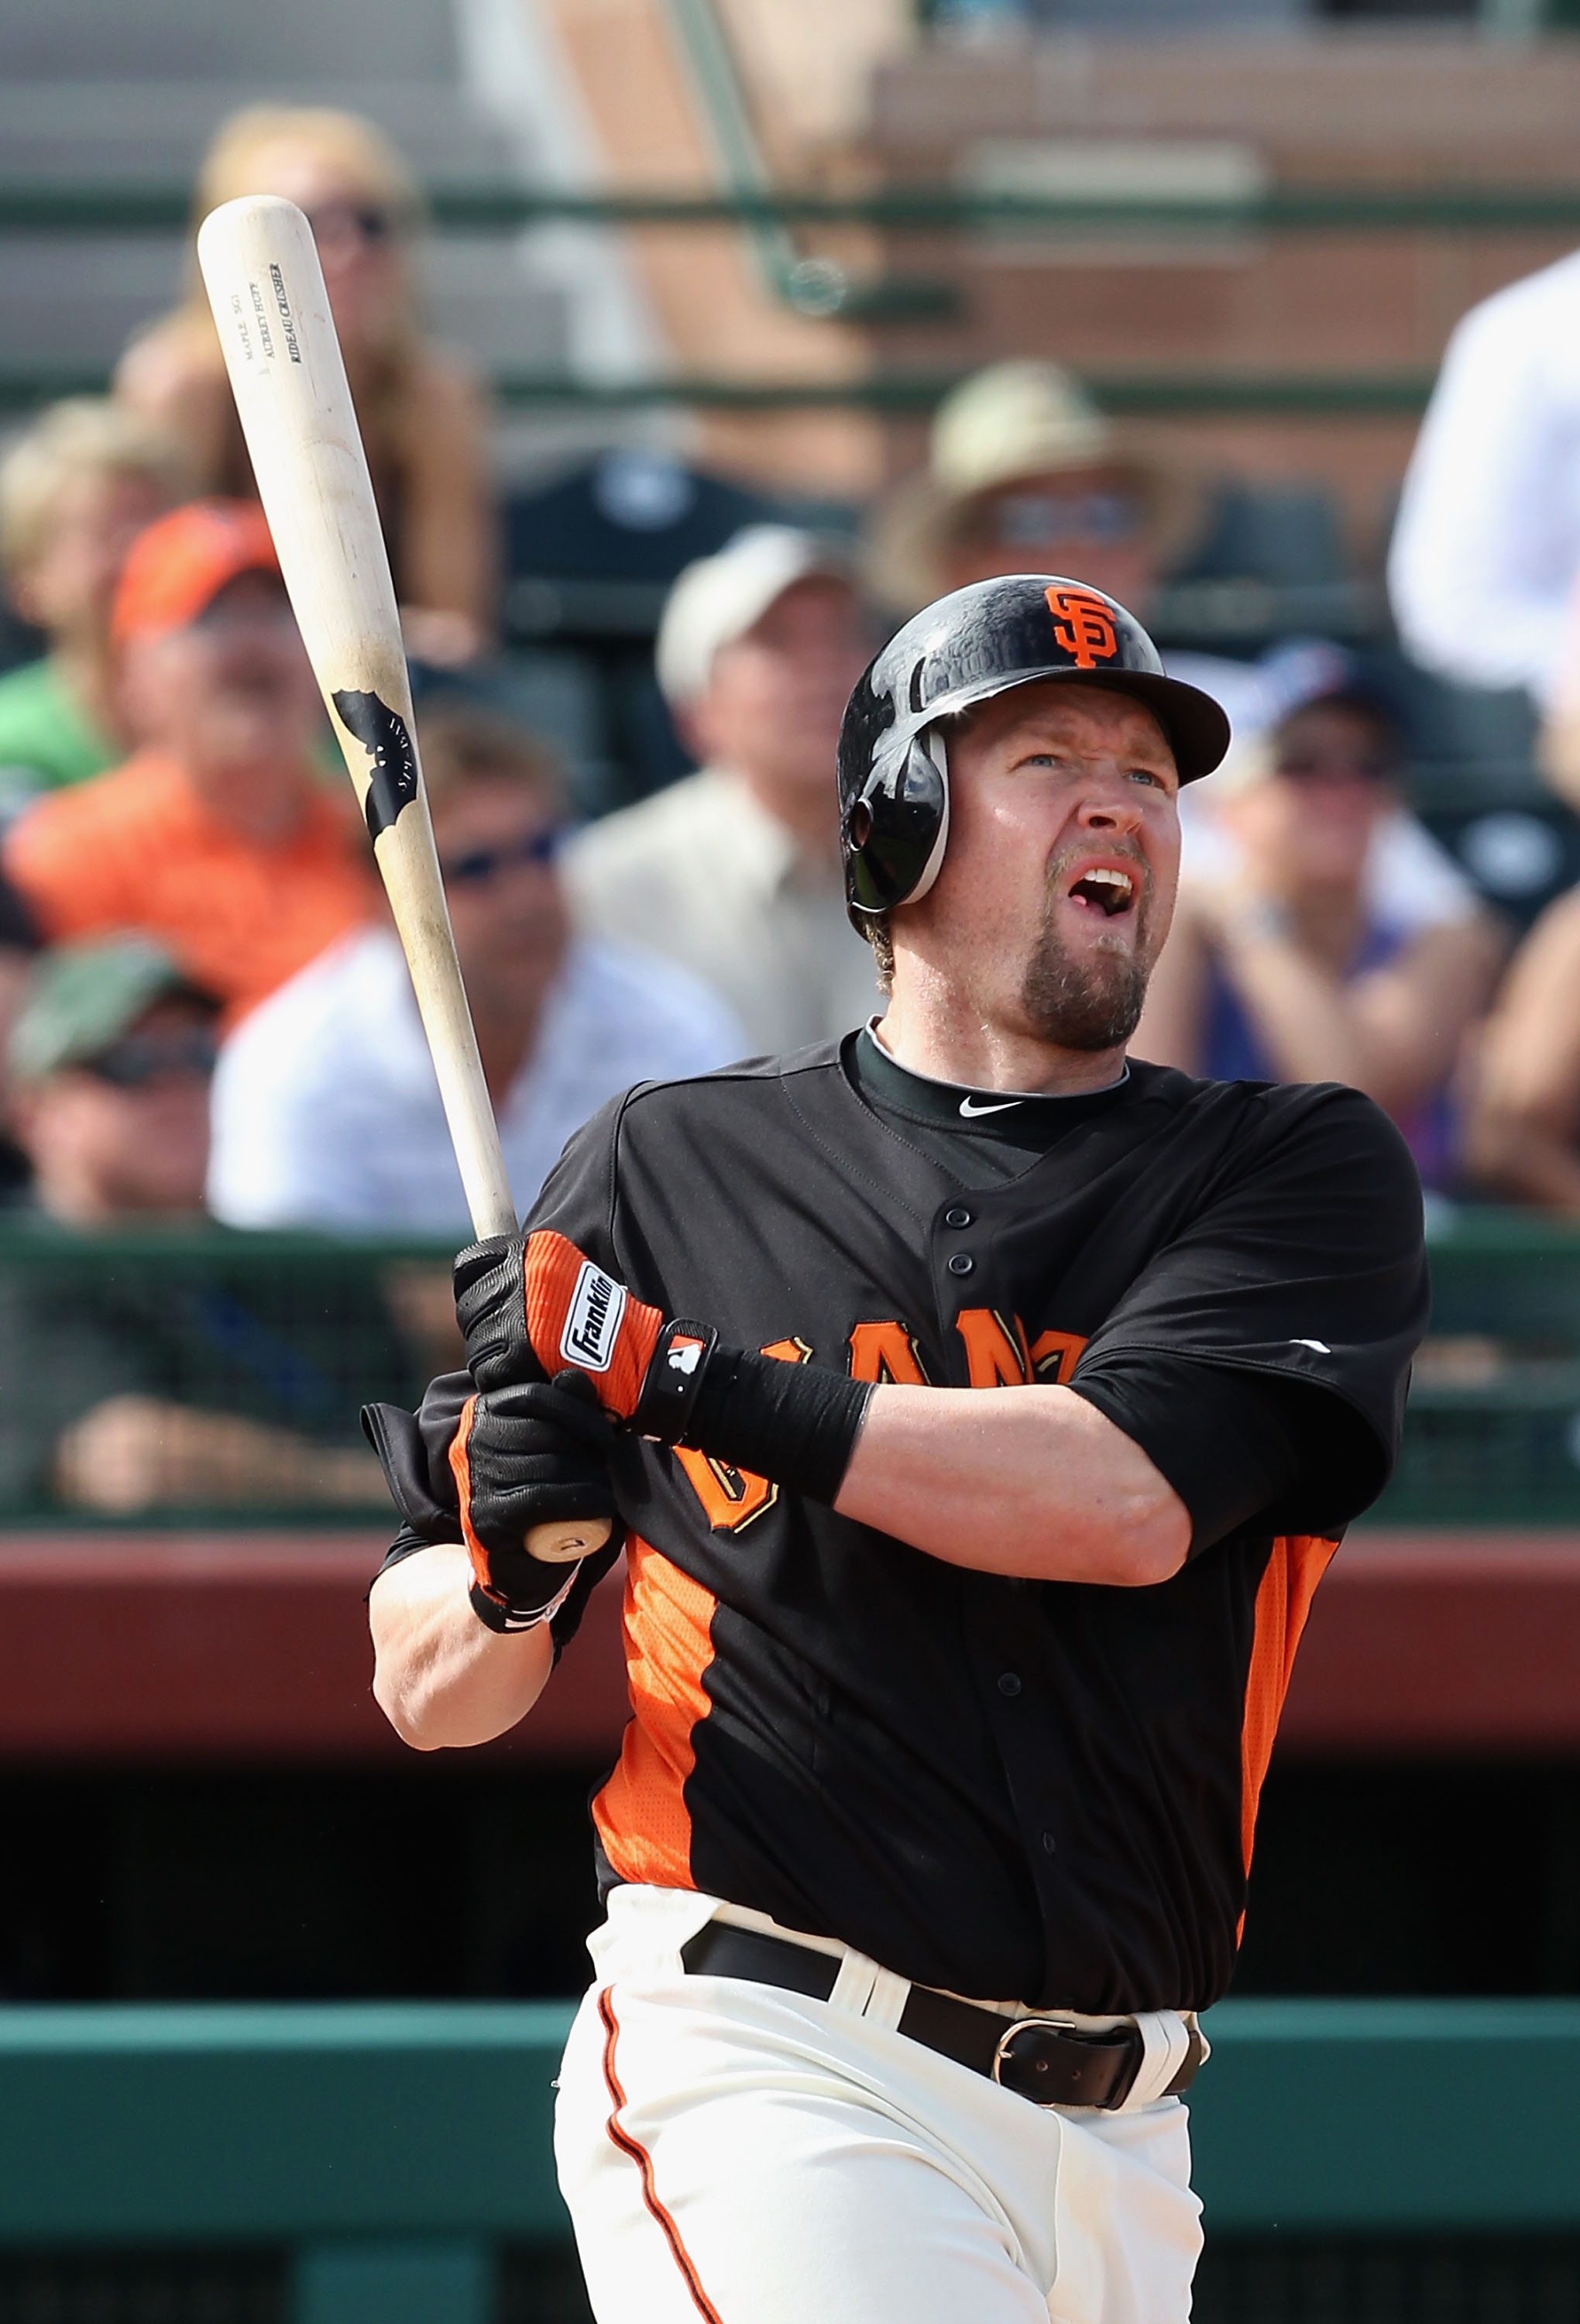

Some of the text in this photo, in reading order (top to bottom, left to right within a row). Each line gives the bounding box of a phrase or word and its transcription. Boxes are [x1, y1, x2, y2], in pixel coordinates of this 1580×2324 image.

[239, 322, 253, 359] MAPLE
[249, 283, 276, 359] AUBREY HUFF
[270, 264, 302, 363] RIDEAU CRUSHER
[1043, 583, 1118, 669] SF
[572, 1276, 613, 1363] Franklin
